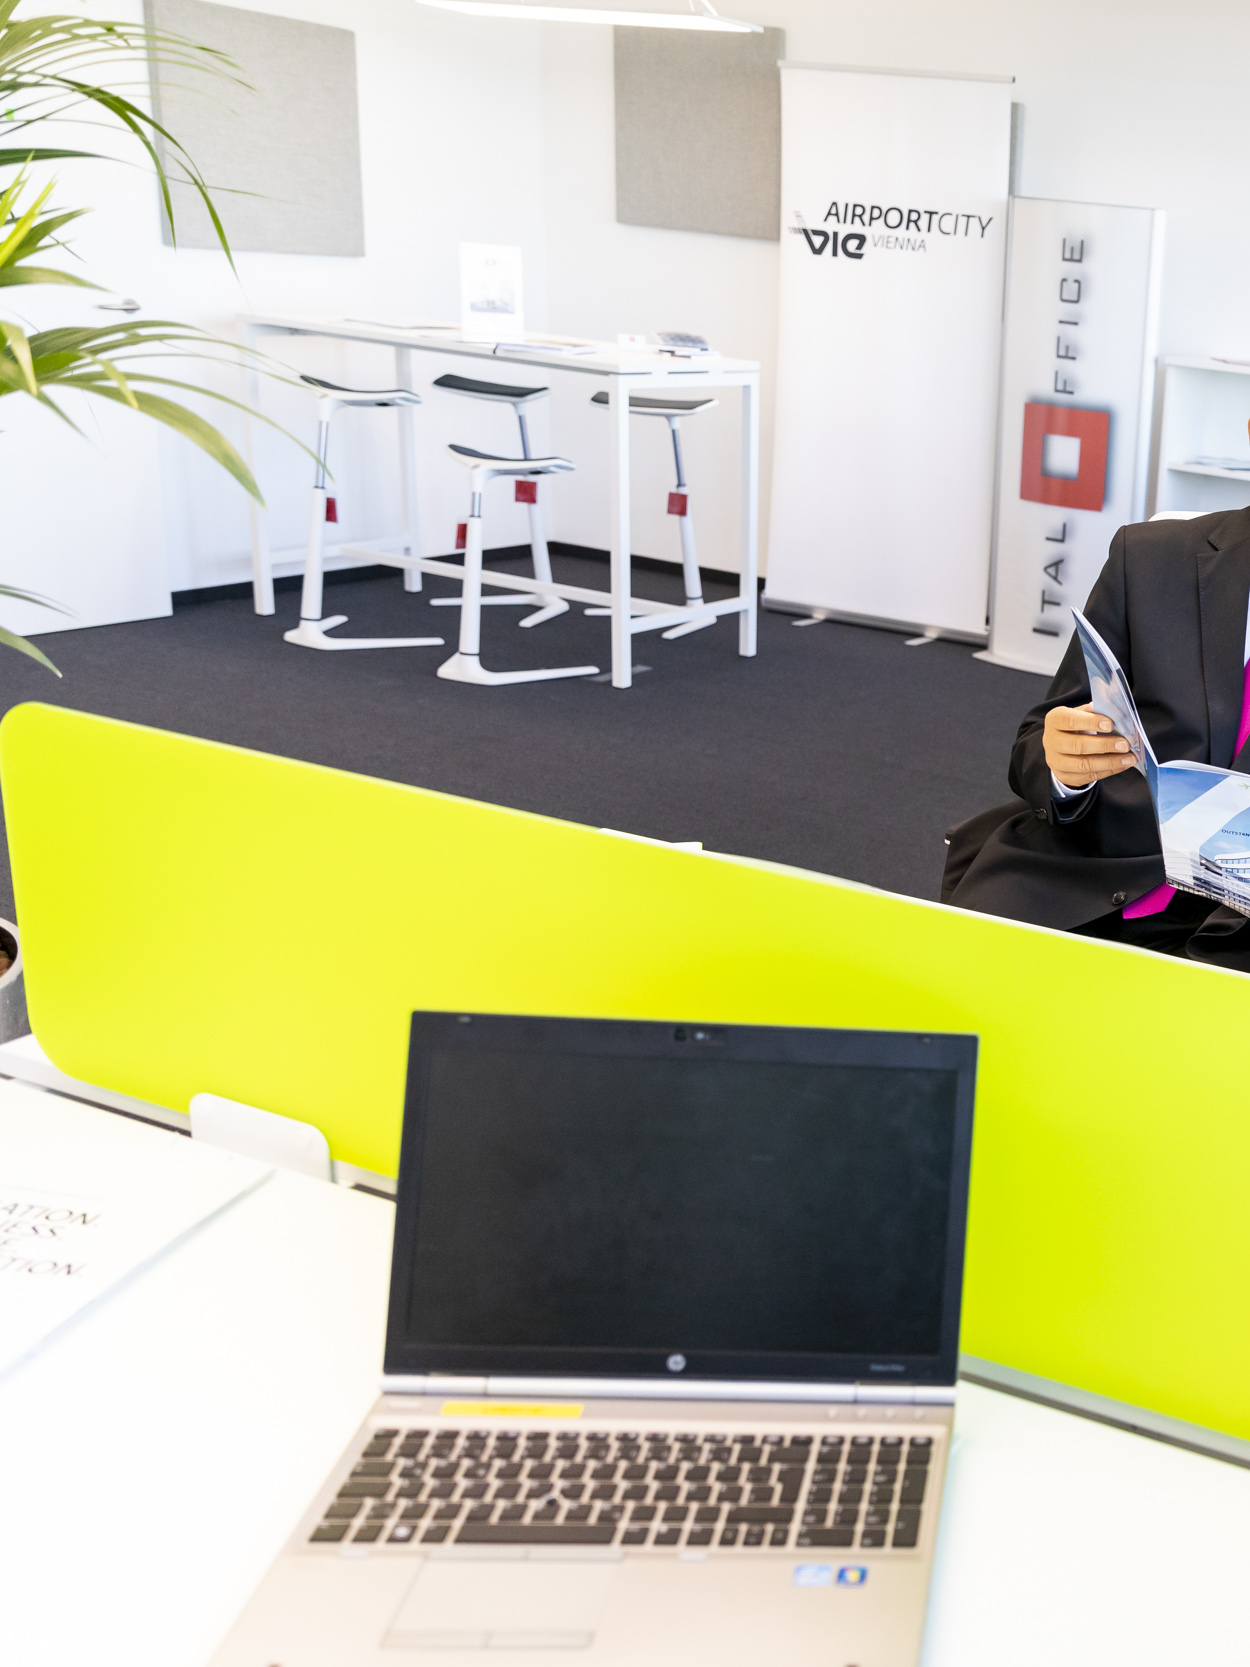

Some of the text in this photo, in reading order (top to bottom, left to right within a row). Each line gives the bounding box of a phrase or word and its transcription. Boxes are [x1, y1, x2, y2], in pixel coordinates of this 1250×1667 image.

[823, 201, 994, 239] AIRPORTCITY
[871, 223, 928, 253] VIENNA
[0, 1202, 101, 1227] ATION.
